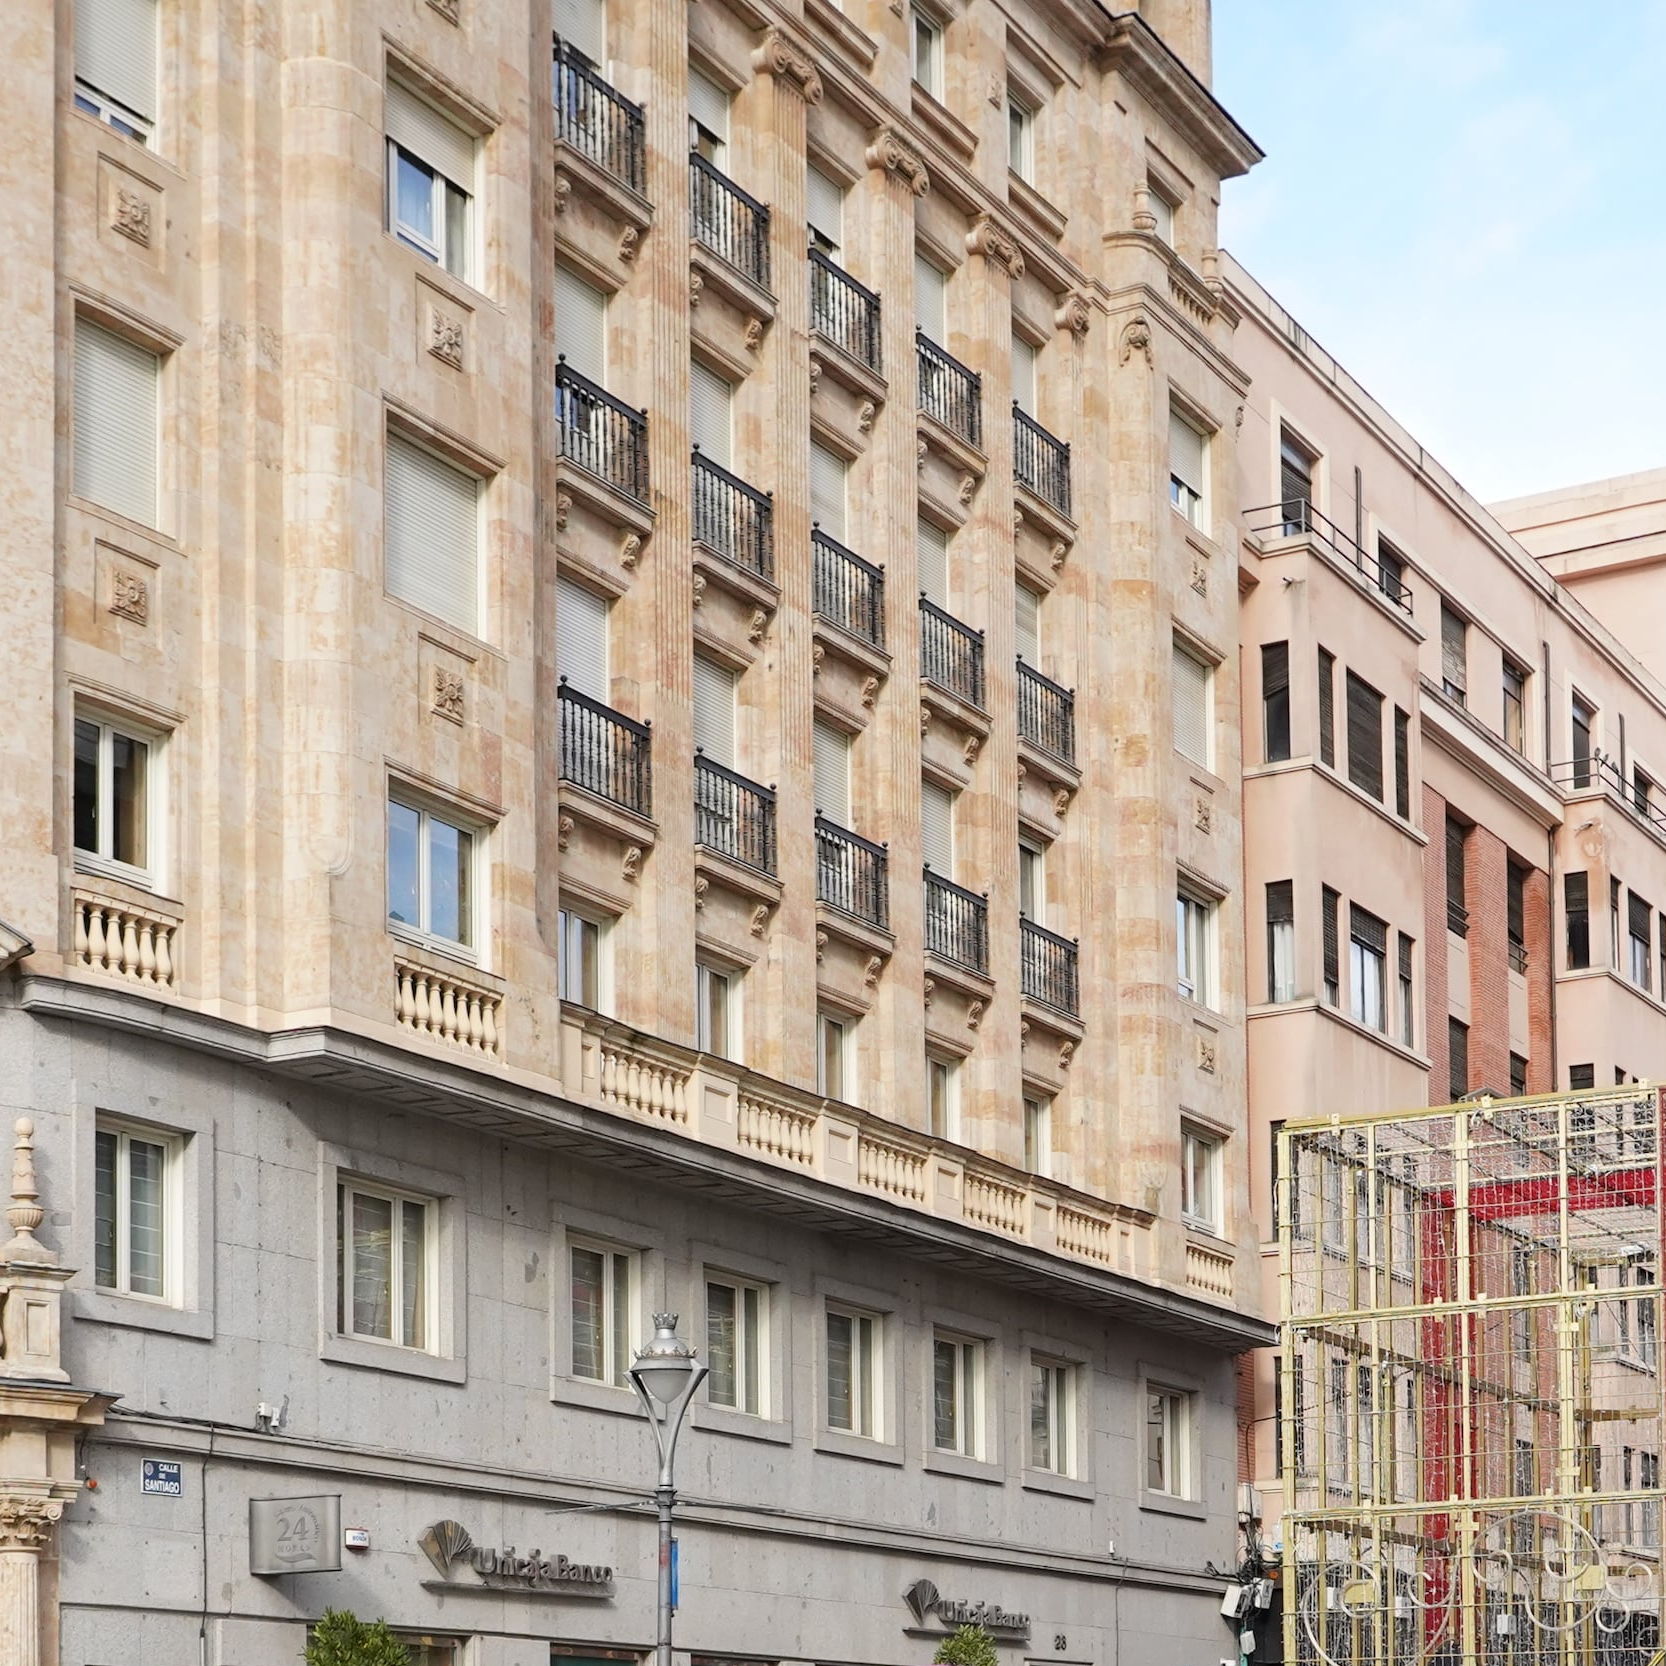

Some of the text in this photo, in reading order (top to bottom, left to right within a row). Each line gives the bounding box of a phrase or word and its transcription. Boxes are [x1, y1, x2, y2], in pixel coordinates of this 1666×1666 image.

[158, 1463, 179, 1473] CALLE
[144, 1479, 180, 1494] SANTIAGO
[276, 1516, 310, 1542] 24
[475, 1546, 614, 1584] Unicaja Banco
[940, 1599, 1032, 1629] Unicaja Banco
